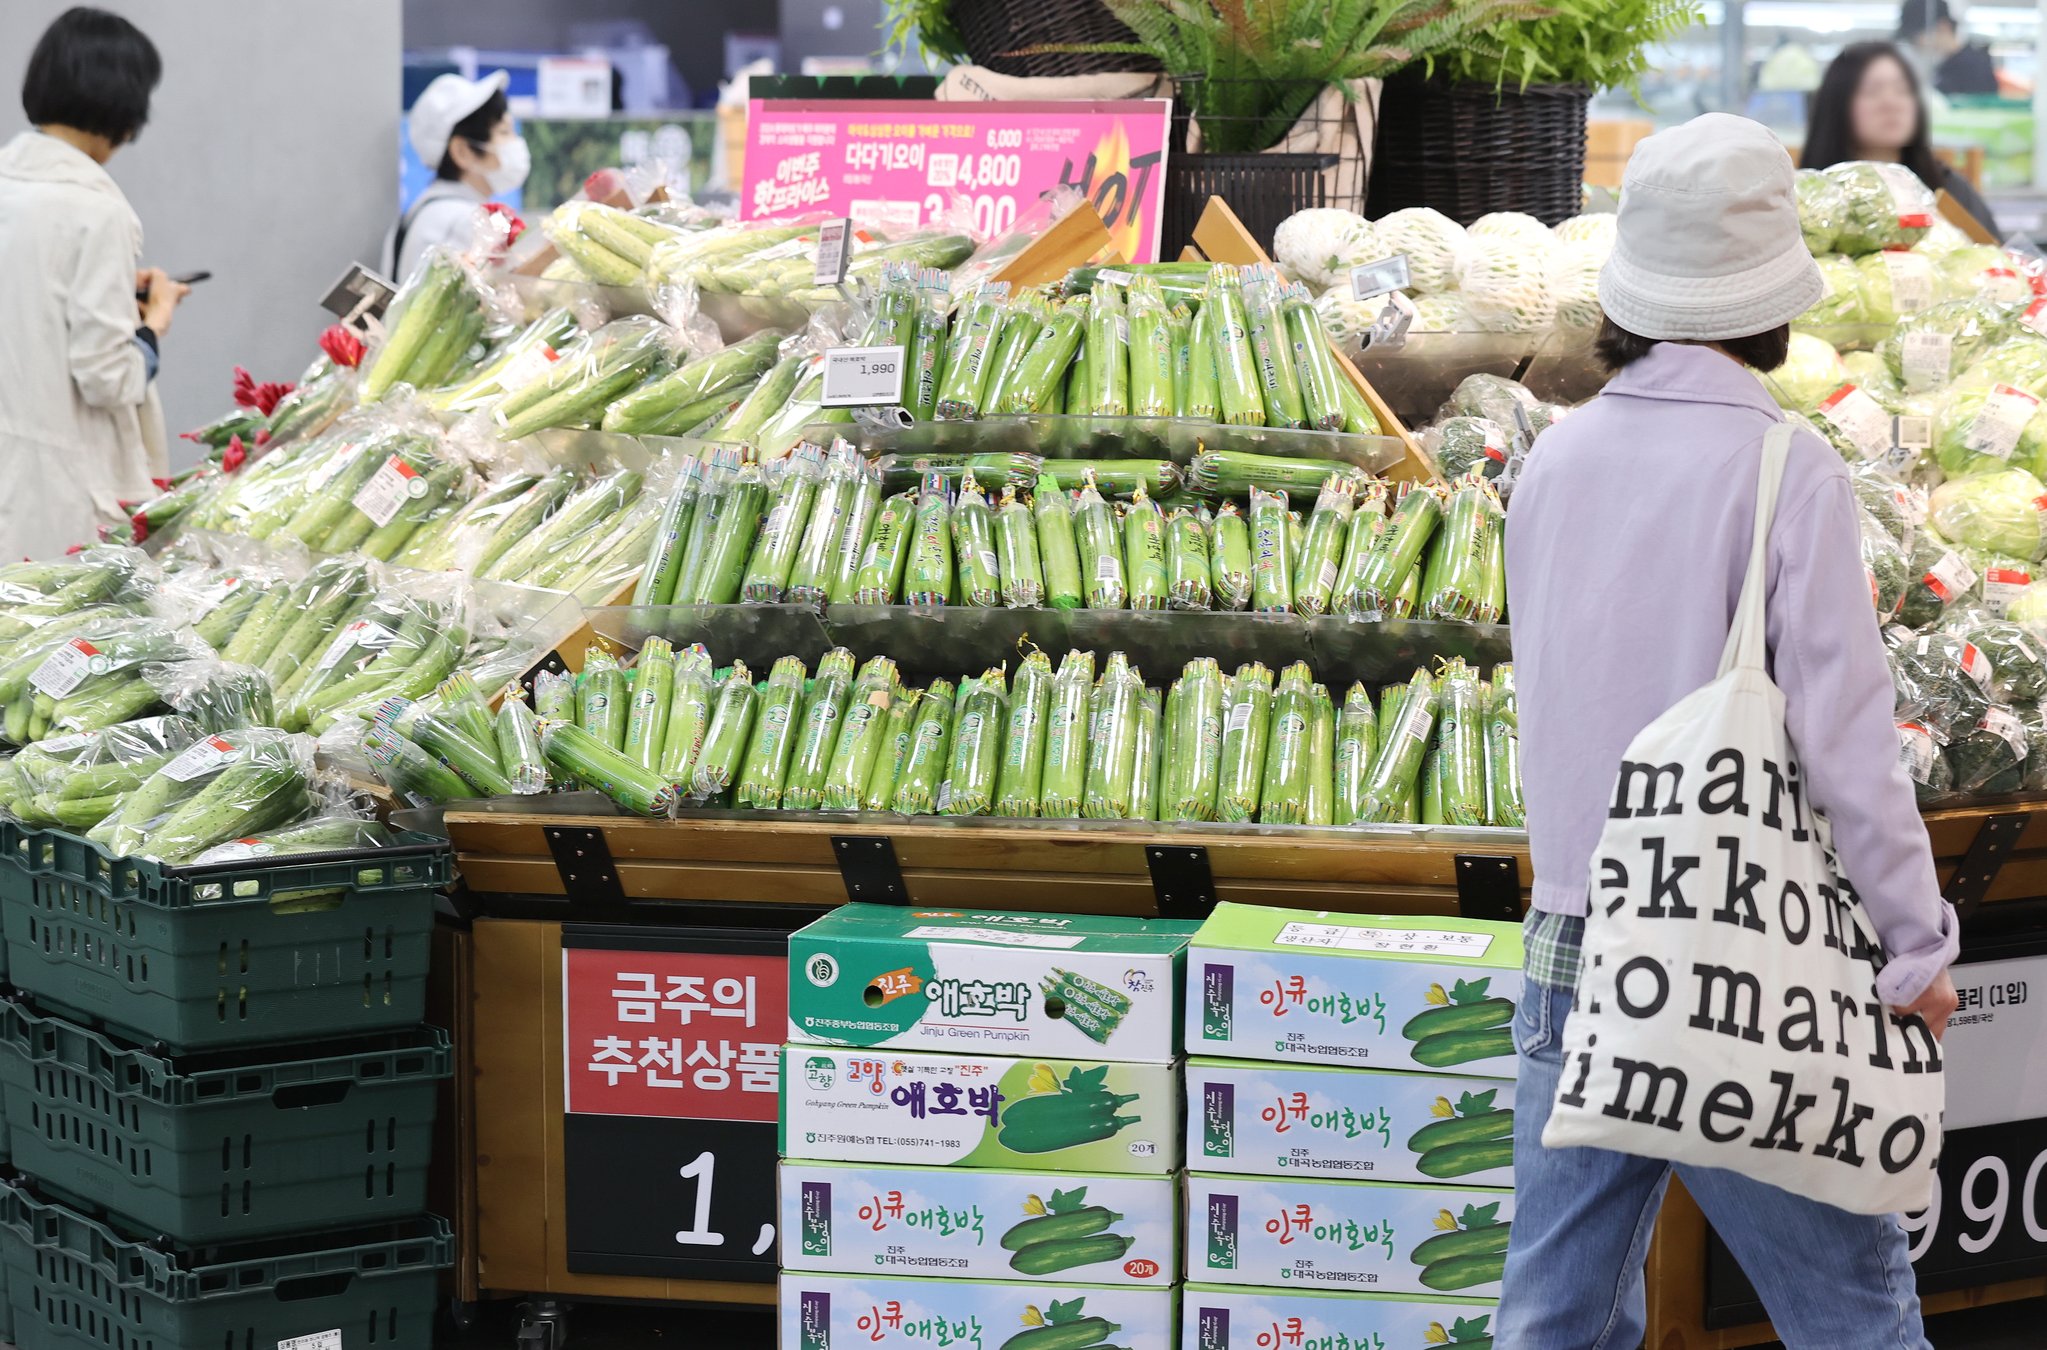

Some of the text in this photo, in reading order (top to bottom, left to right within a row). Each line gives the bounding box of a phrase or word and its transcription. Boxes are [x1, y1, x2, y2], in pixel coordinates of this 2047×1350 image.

[987, 129, 1022, 148] 6,000
[776, 151, 821, 184] 이번주
[845, 142, 925, 171] 다다기오이
[958, 154, 1021, 190] 4,800
[752, 177, 831, 218] 핫프라이스
[1039, 151, 1162, 229] HOT
[860, 363, 896, 375] 1,990
[611, 972, 757, 1028] 금주의
[877, 975, 1031, 1022] 진주 애호박
[1260, 975, 1387, 1035] 인큐 애호박
[1989, 981, 2027, 1007] (1입)
[815, 1018, 900, 1032] 진주중부농업협동조합
[920, 1027, 1030, 1041] Jinju Green Pumpkin
[1287, 1033, 1305, 1042] 진주
[1285, 1042, 1369, 1057] 대곡농업협동조합
[588, 1035, 780, 1093] 추천상품
[808, 1070, 833, 1088] 고향
[850, 1061, 884, 1094] 고향
[805, 1100, 889, 1111] Gohyang Green Pumpkin
[891, 1081, 1005, 1127] 애호박
[1262, 1092, 1391, 1148] 인큐 애호박
[817, 1133, 961, 1148] 진주원예농협 TEL:(055)741-1983
[1131, 1143, 1156, 1155] 20개
[1289, 1157, 1374, 1170] 대곡농업협동조합
[1291, 1148, 1309, 1157] 진주
[675, 1151, 776, 1256] 1,
[858, 1190, 985, 1246] 인큐 애호박
[1266, 1204, 1394, 1261] 인큐 애호박
[887, 1245, 905, 1254] 진주
[884, 1254, 969, 1268] 대곡농업협동조합
[1129, 1261, 1154, 1275] 20개
[1294, 1260, 1314, 1269] 진주
[1293, 1269, 1378, 1283] 대곡농업협동조합
[857, 1301, 983, 1350] 인큐 애호박
